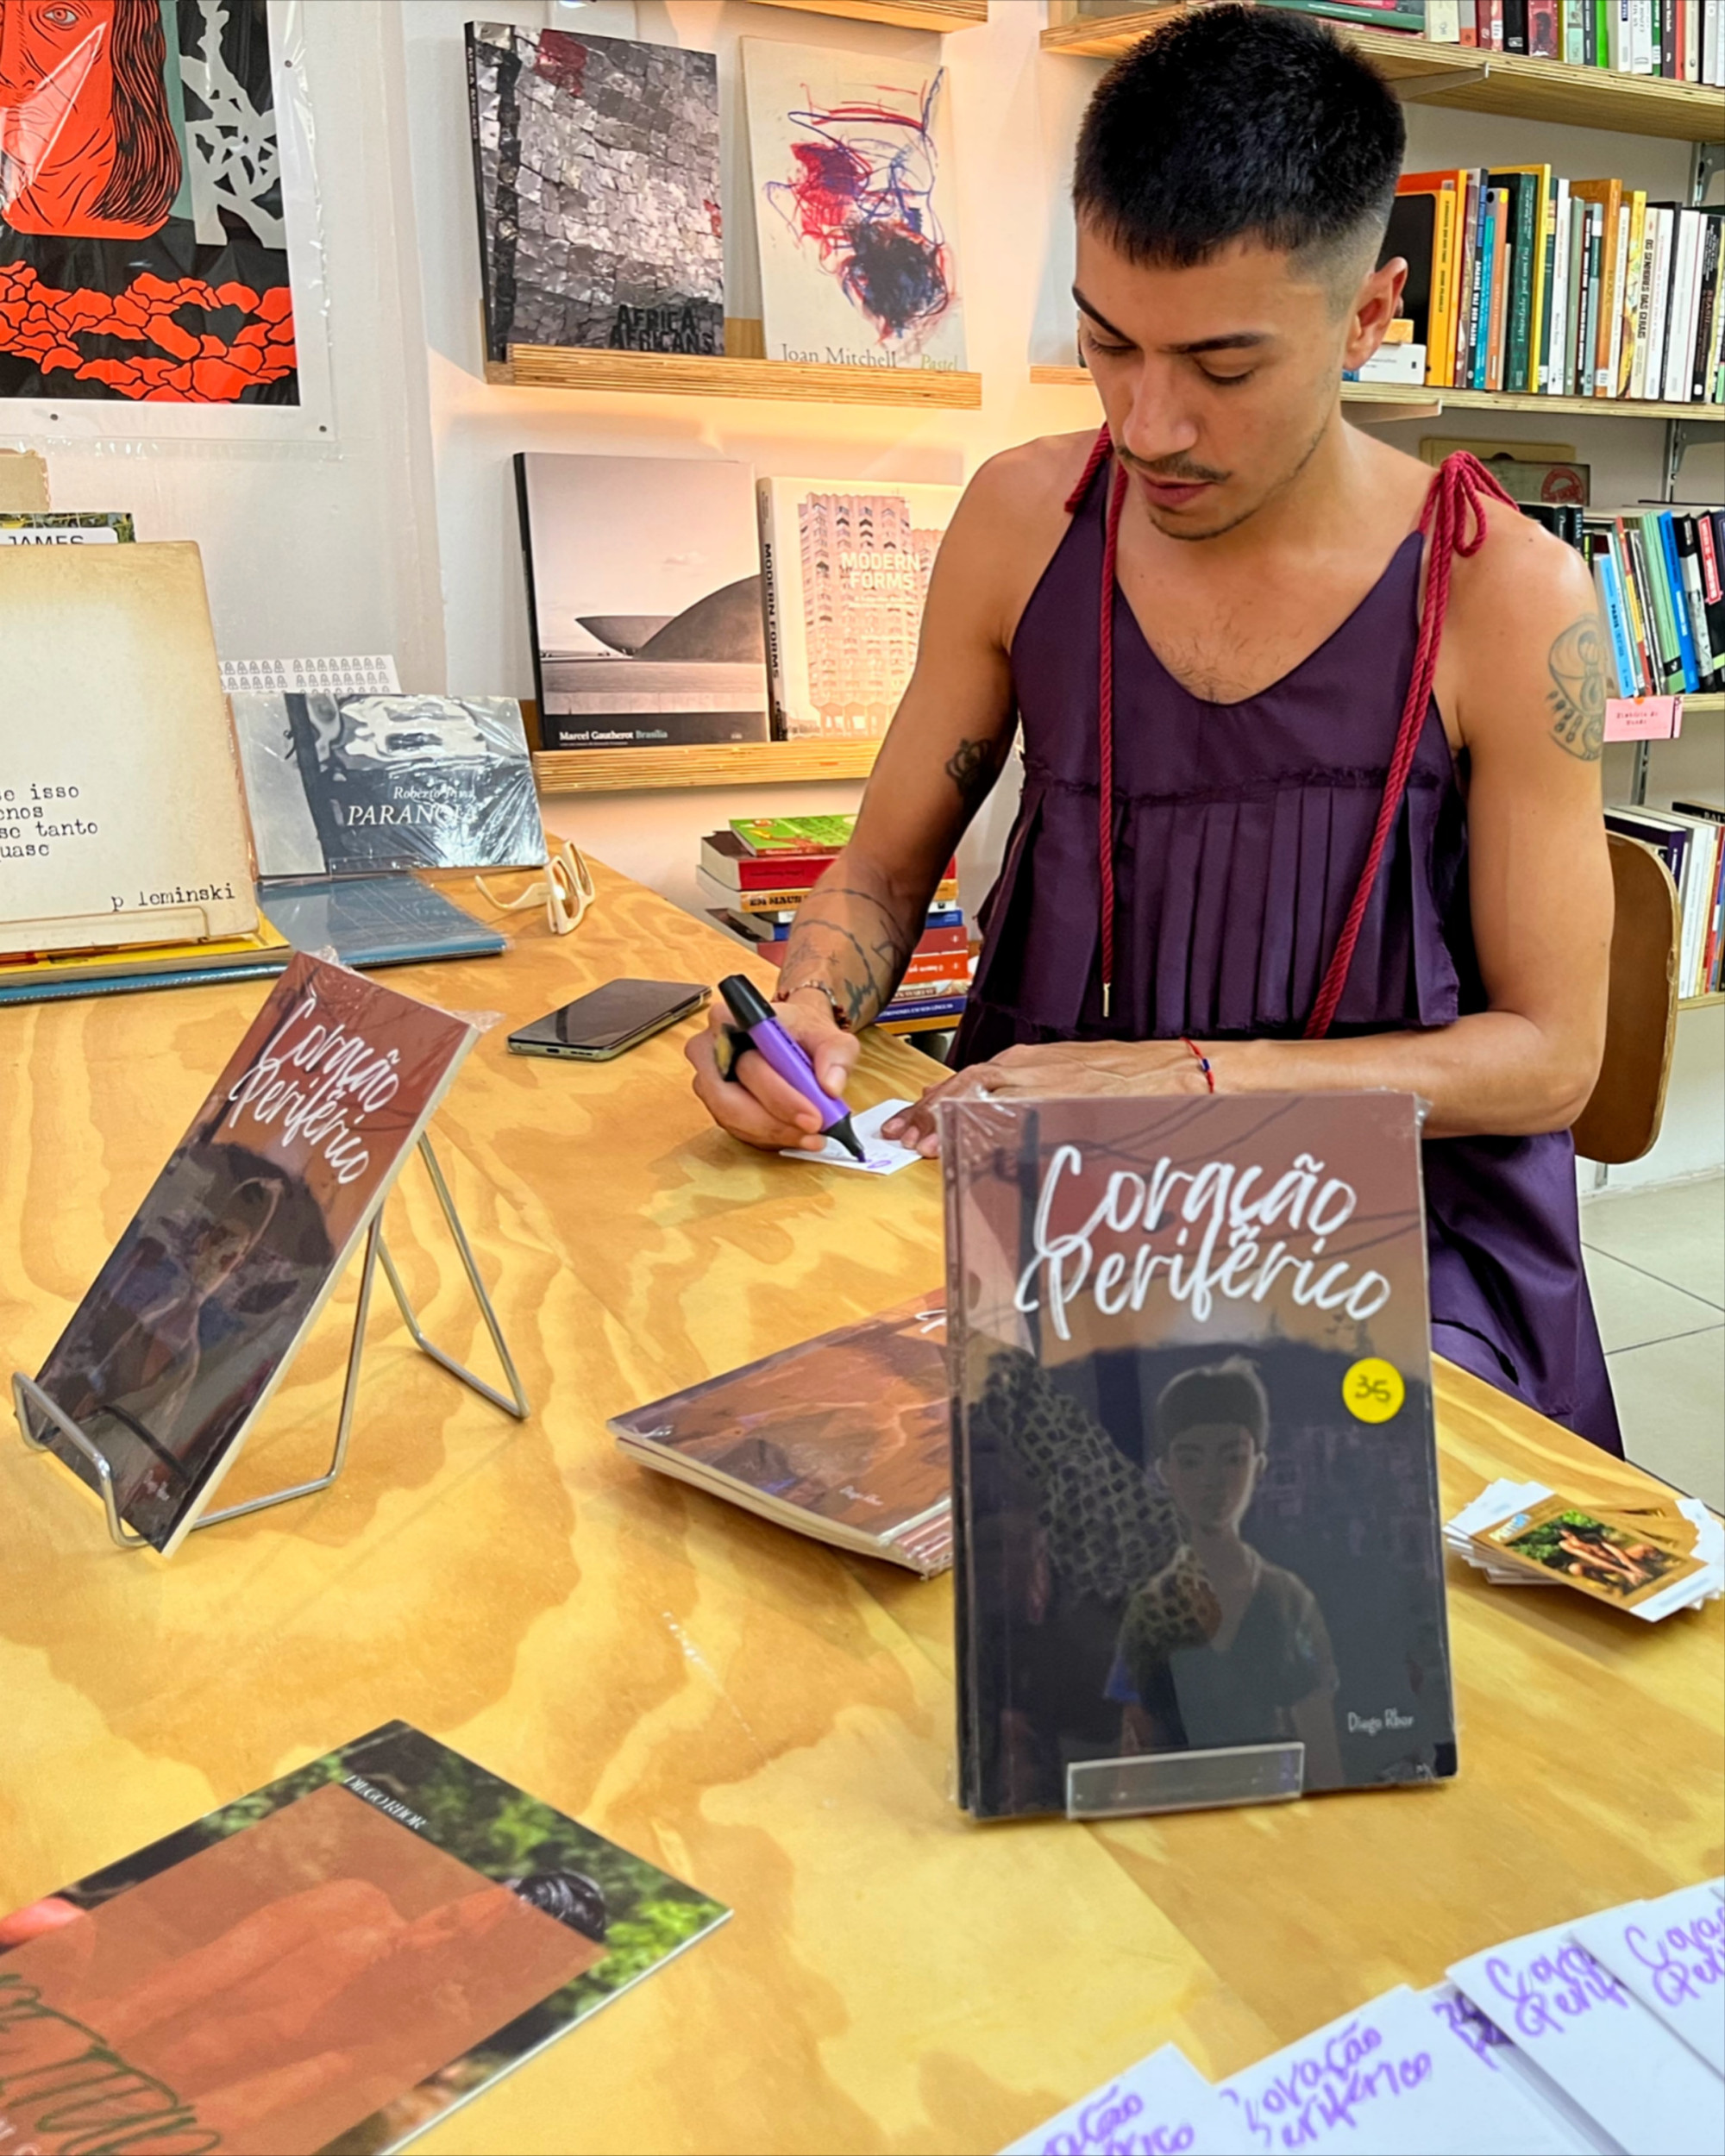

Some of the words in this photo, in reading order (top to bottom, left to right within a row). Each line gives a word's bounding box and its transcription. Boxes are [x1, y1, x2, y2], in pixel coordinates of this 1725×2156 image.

[1645, 239, 1653, 250] OS
[1471, 260, 1483, 291] AMANHÃ
[1640, 252, 1653, 292] SENHORES
[1471, 292, 1480, 306] VAI
[1639, 294, 1650, 310] DAS
[1517, 297, 1529, 342] Liberdade
[1637, 311, 1648, 340] GERAIS
[1469, 323, 1479, 347] MAIOR
[781, 343, 819, 362] Joan
[825, 347, 896, 368] Mitchell
[841, 552, 920, 571] MODERN
[764, 543, 775, 616] MODERN
[850, 571, 915, 589] FORMS
[560, 731, 590, 741] Marcel
[591, 730, 633, 740] Gautherot
[0, 788, 16, 802] e
[31, 783, 79, 801] isso
[35, 819, 98, 837] tanto
[0, 843, 50, 862] uase
[111, 896, 124, 912] p
[138, 883, 235, 906] leminski
[1034, 1145, 1358, 1258] Coração
[1354, 1373, 1392, 1404] 35
[1347, 1711, 1383, 1737] Diego
